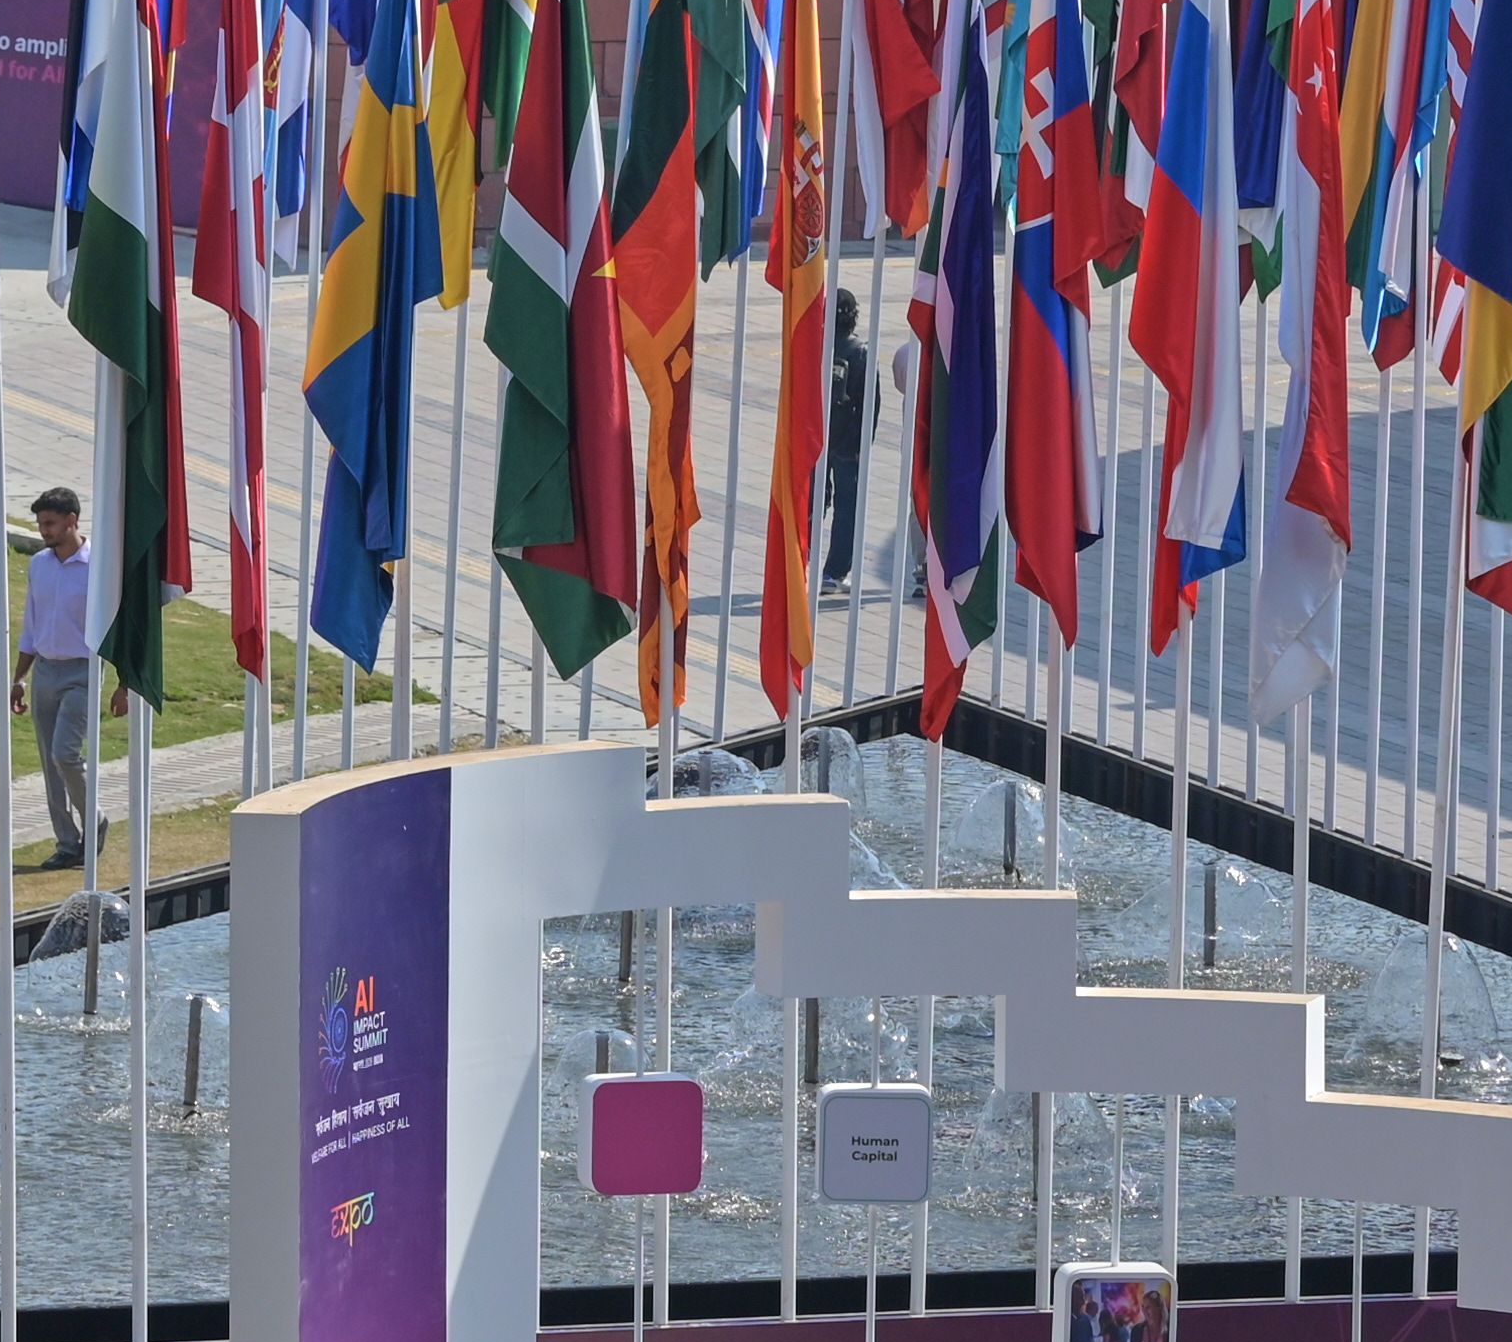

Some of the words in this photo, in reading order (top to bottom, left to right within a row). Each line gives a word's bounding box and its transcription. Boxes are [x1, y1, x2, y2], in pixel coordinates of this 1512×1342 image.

[9, 60, 38, 80] for
[355, 976, 375, 1017] AI
[353, 1011, 386, 1036] IMPACT
[353, 1028, 388, 1053] SUMMIT
[351, 1122, 386, 1145] HAPPINESS
[386, 1119, 396, 1134] OF
[397, 1116, 410, 1130] ALL
[851, 1135, 900, 1149] Human
[851, 1149, 899, 1164] Capital
